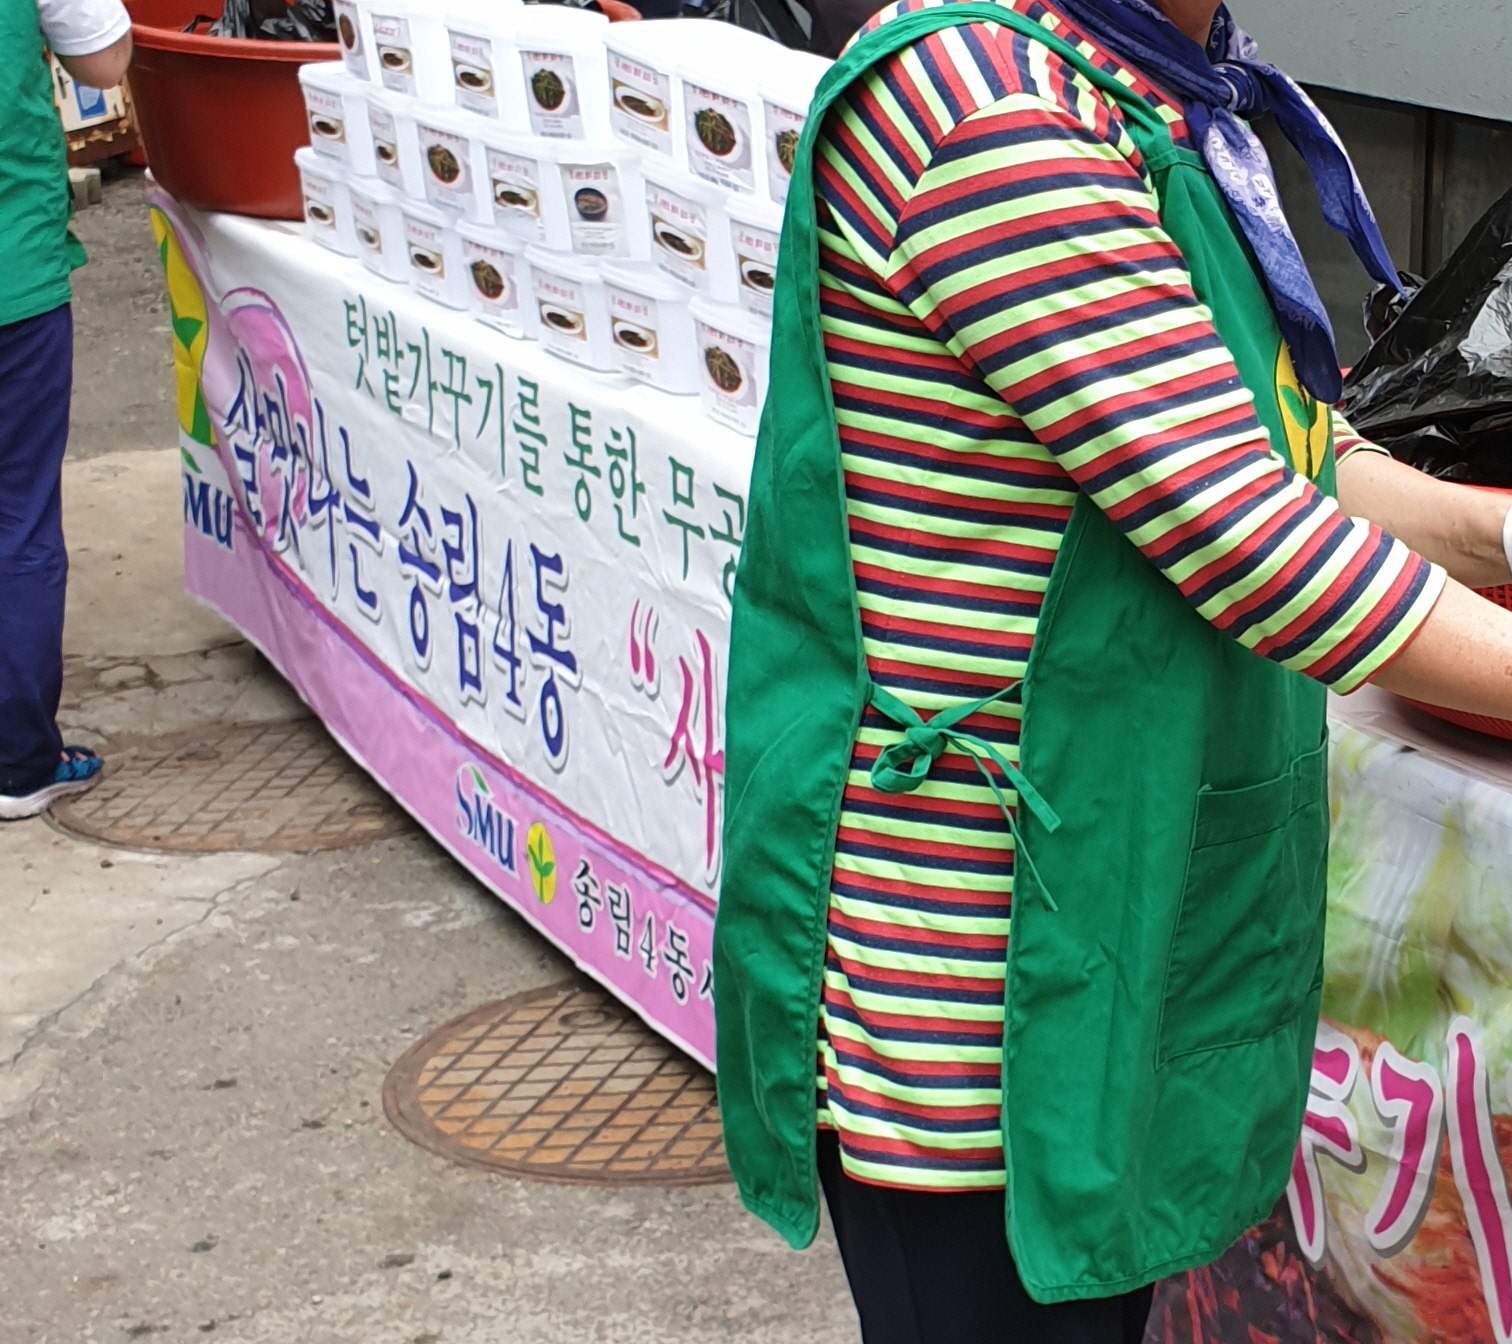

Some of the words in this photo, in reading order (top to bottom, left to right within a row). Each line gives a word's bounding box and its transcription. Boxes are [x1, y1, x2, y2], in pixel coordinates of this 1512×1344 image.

[343, 293, 548, 497] 텃밭가꾸기를
[563, 401, 646, 548] 통한
[224, 346, 380, 610] 살맛나는
[399, 459, 577, 757] 송림4동
[456, 768, 515, 872] SMU
[574, 859, 714, 1001] 송림4동
